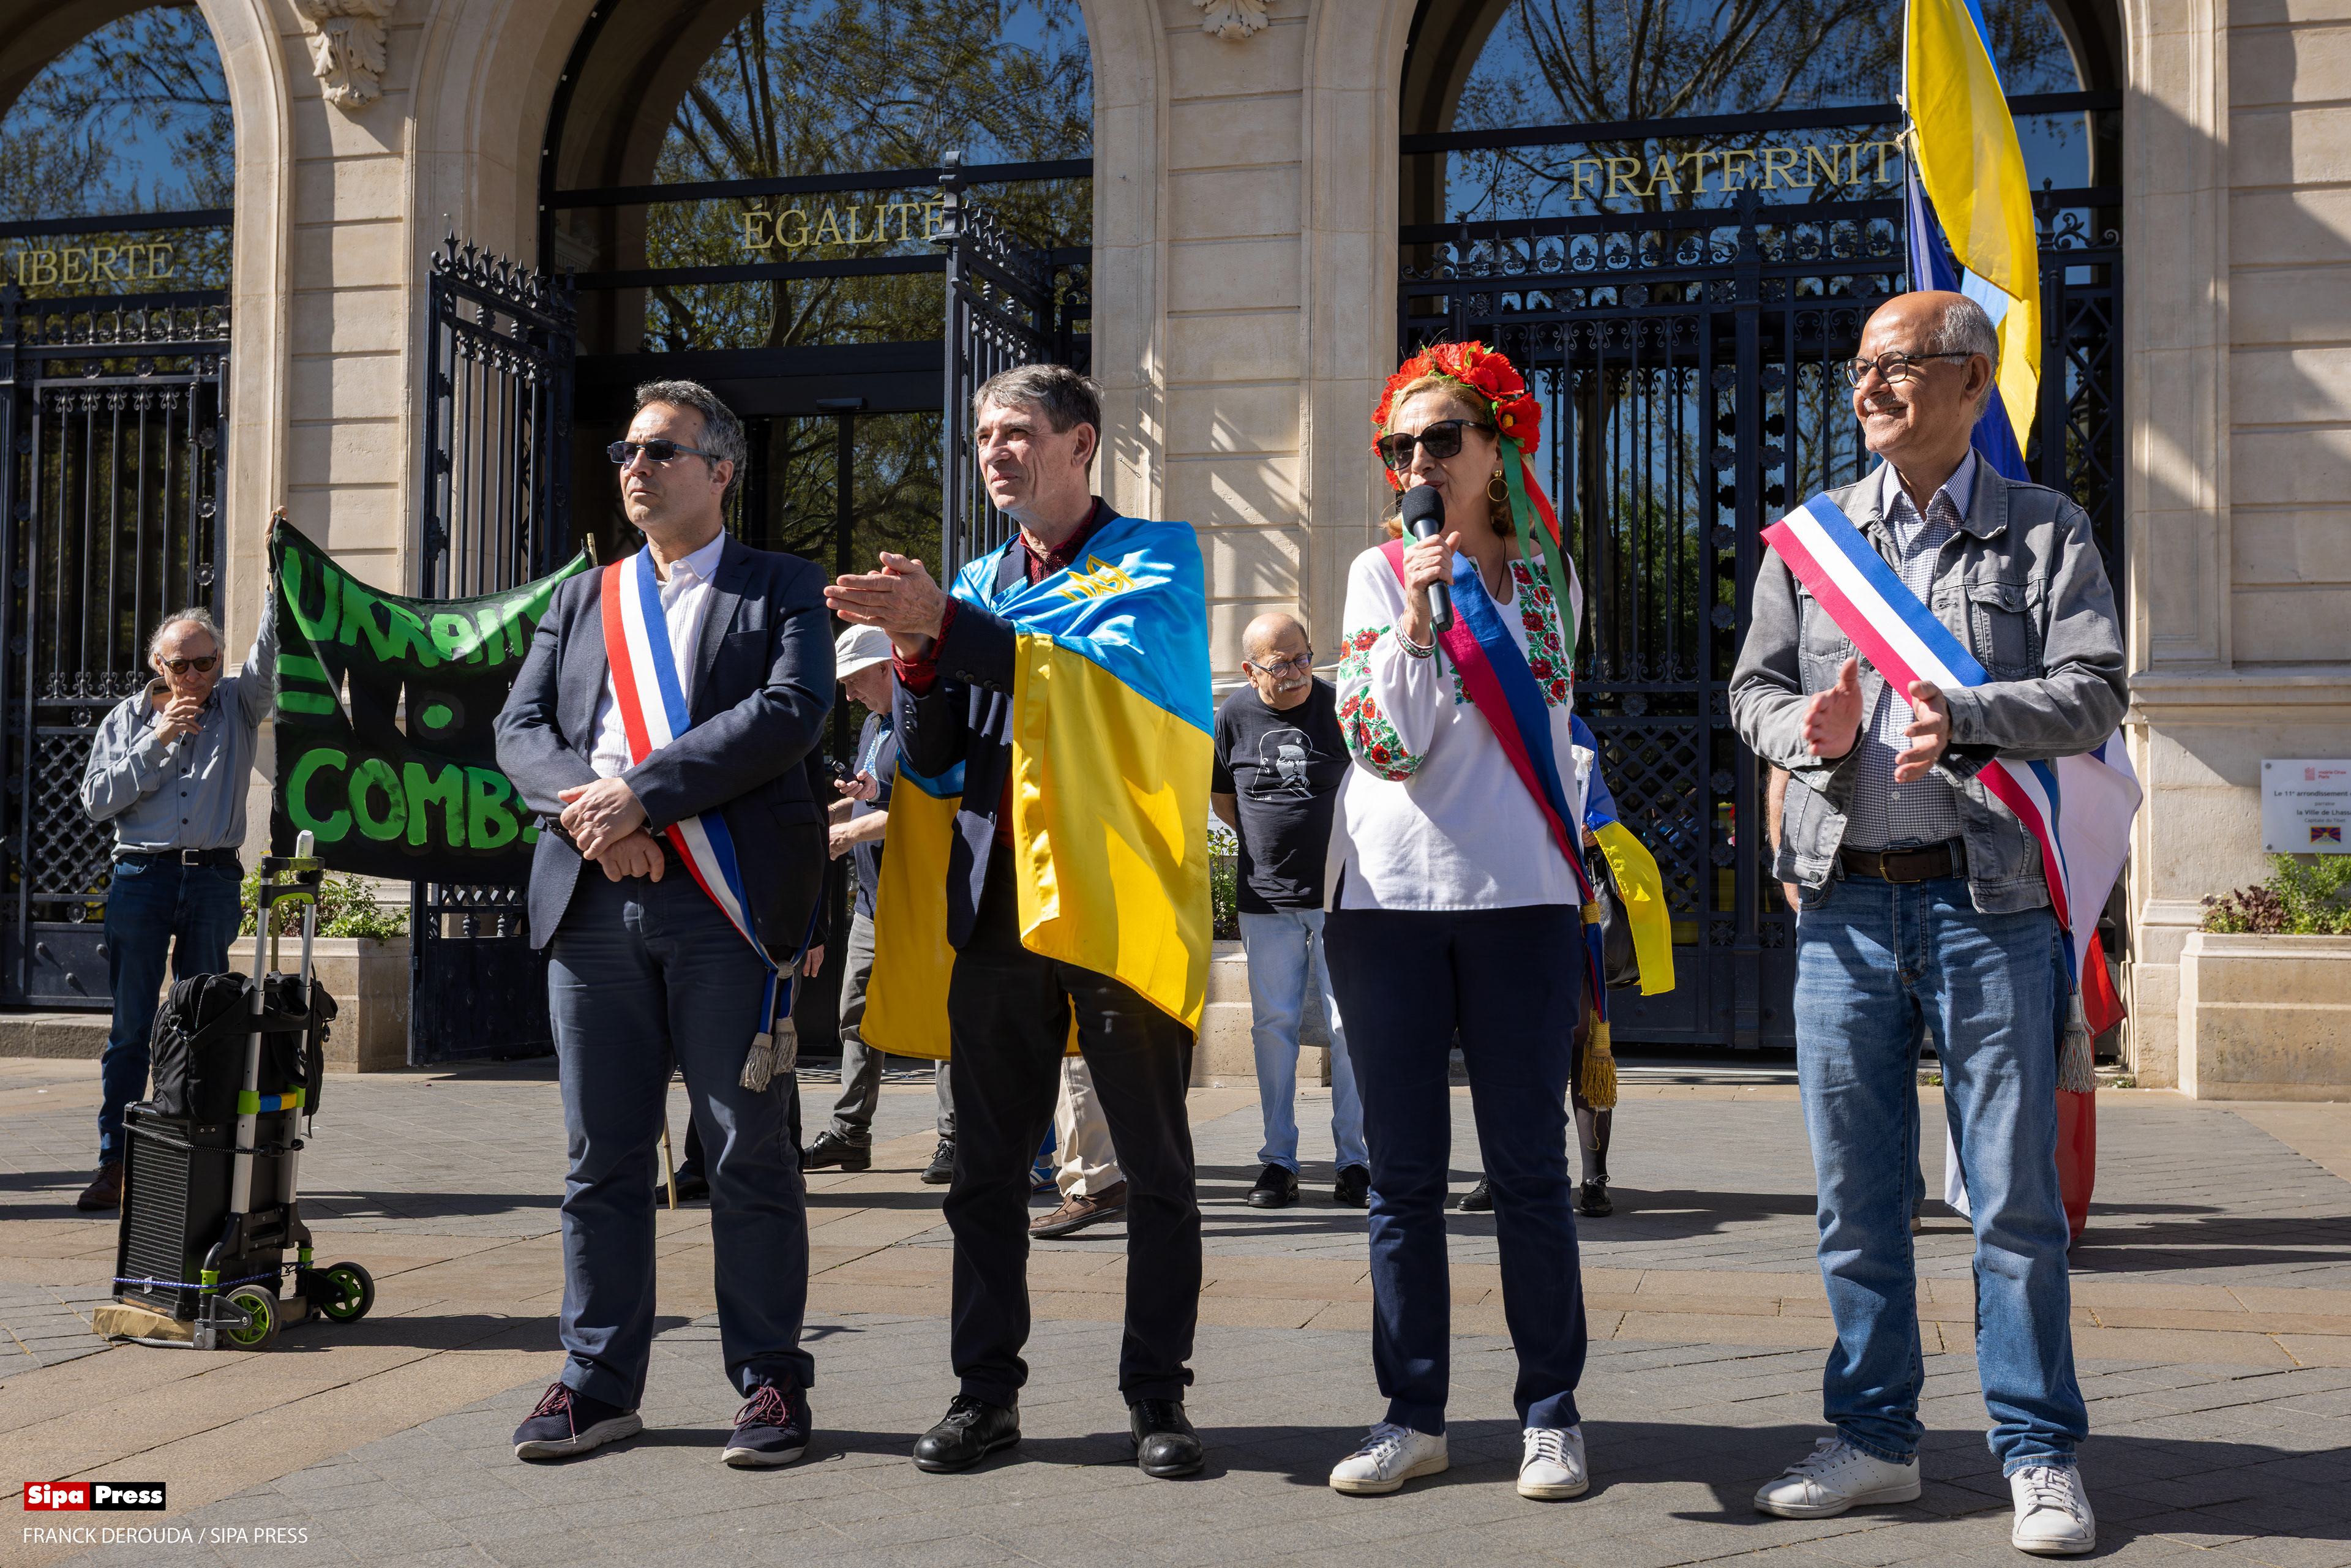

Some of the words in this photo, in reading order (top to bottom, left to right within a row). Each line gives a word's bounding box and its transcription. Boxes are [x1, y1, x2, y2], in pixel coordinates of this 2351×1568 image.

[1569, 140, 1921, 200] FRATERNIT
[741, 192, 945, 249] ÉGALITÉ
[287, 748, 540, 849] COMB
